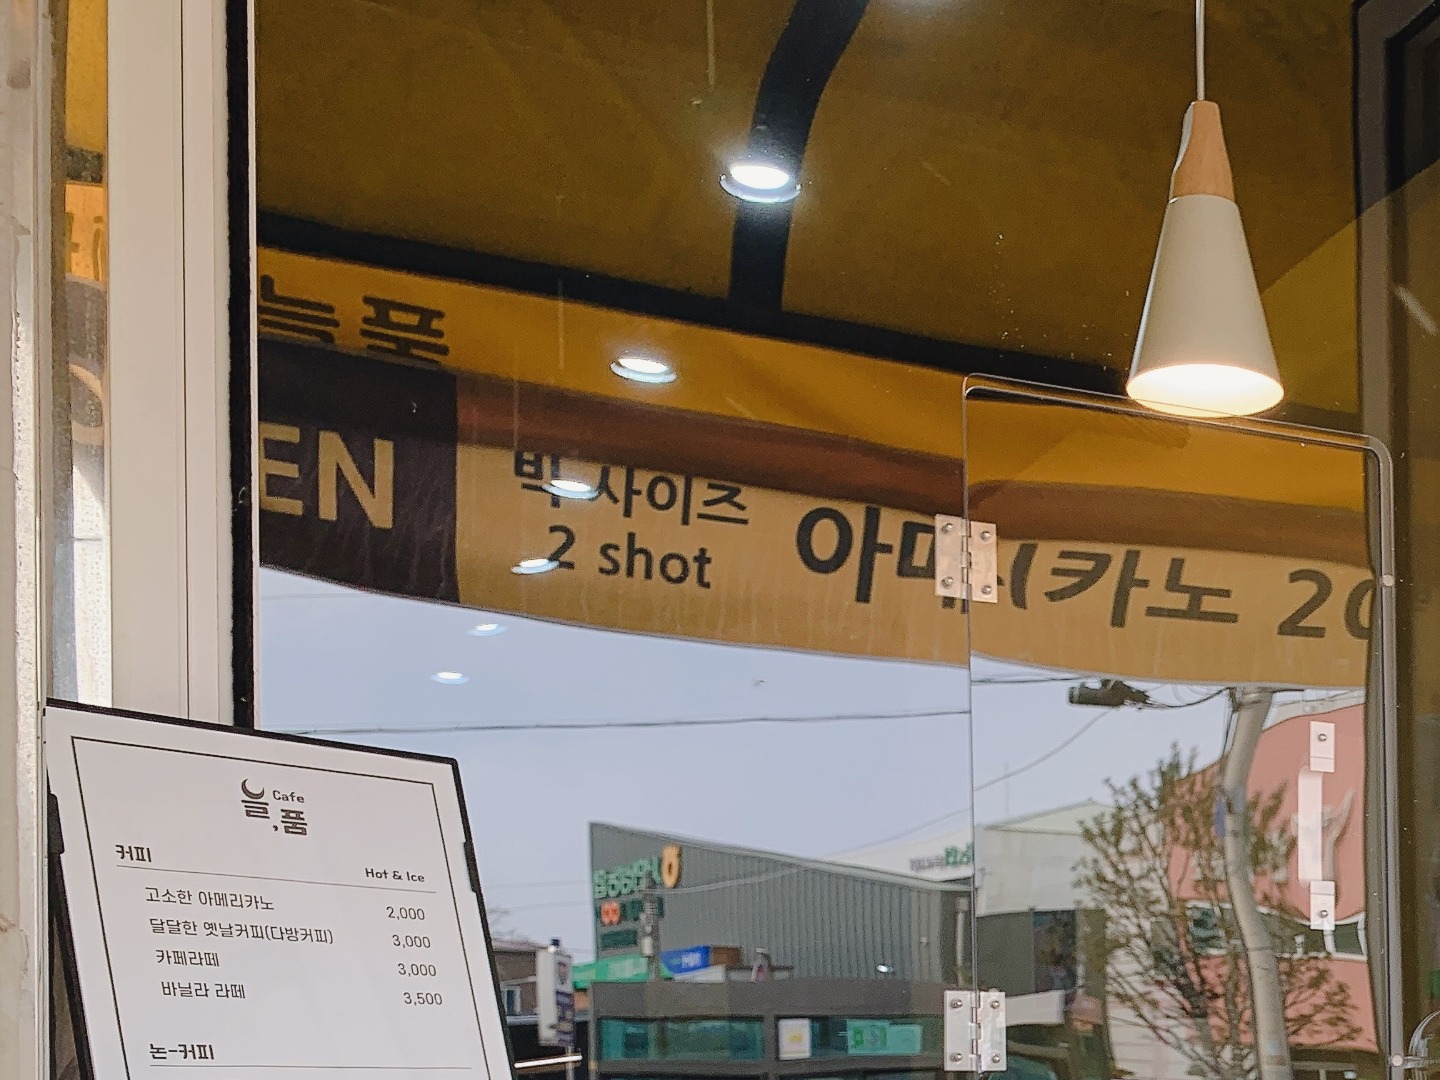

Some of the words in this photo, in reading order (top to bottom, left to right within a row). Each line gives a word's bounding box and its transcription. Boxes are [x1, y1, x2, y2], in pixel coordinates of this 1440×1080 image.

[598, 464, 749, 527] 사이즈
[545, 524, 577, 572] 2
[598, 531, 713, 590] shot
[272, 788, 306, 804] Cafe
[115, 844, 152, 863] 커피
[365, 867, 389, 880] Hot
[392, 870, 404, 881] &
[406, 871, 426, 883] Ice
[145, 886, 193, 905] 고소한
[198, 891, 275, 911] 아메리카노
[386, 906, 426, 921] 2,000
[149, 918, 198, 936] 달달한
[203, 921, 334, 945] 옛날커피(다방커피)
[391, 934, 432, 949] 3,000
[155, 949, 220, 967] 카페라떼
[397, 962, 437, 977] 3,000
[161, 981, 210, 998] 바닐라
[214, 983, 246, 999] 라떼
[403, 991, 443, 1006] 3,500
[149, 1043, 215, 1060] 논-커피
